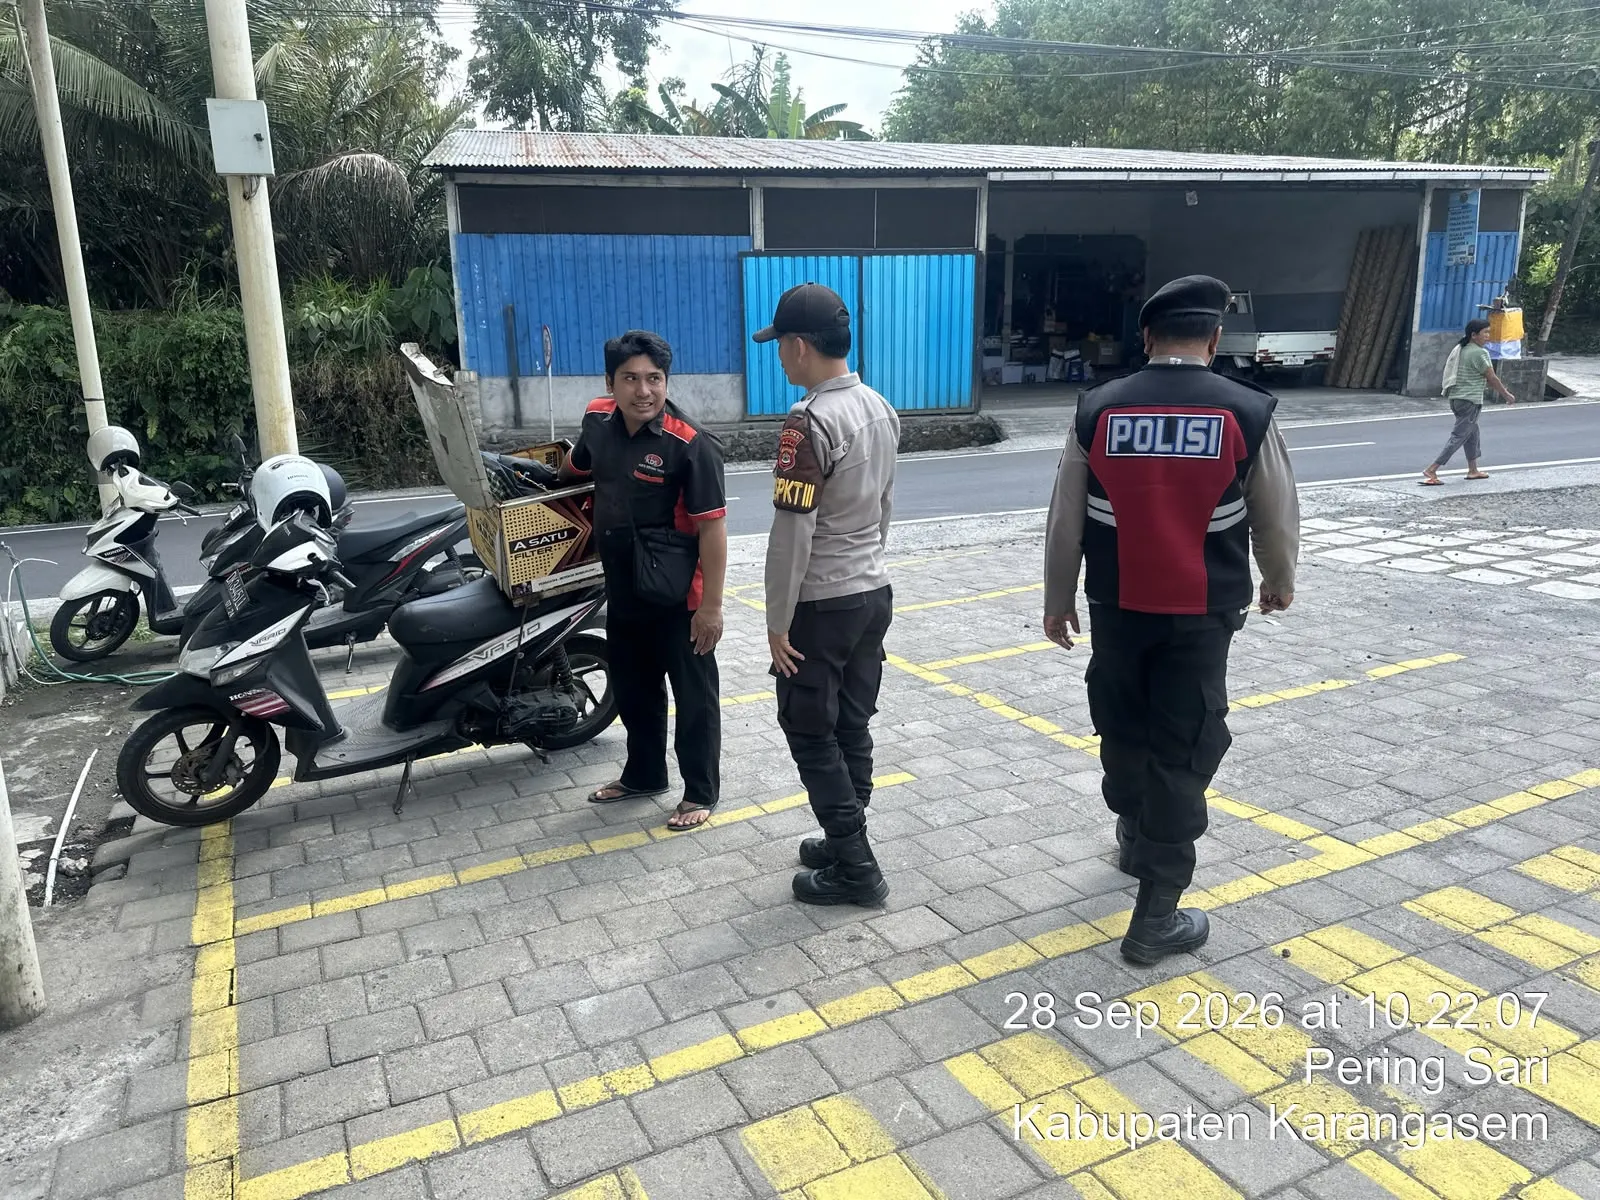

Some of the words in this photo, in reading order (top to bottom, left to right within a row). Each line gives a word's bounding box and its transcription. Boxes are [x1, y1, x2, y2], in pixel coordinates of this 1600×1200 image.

[1110, 417, 1220, 455] POLISI
[801, 482, 815, 508] III
[513, 541, 527, 551] A
[528, 530, 568, 547] SATU
[104, 547, 125, 557] HONDA
[514, 546, 553, 561] FILTER
